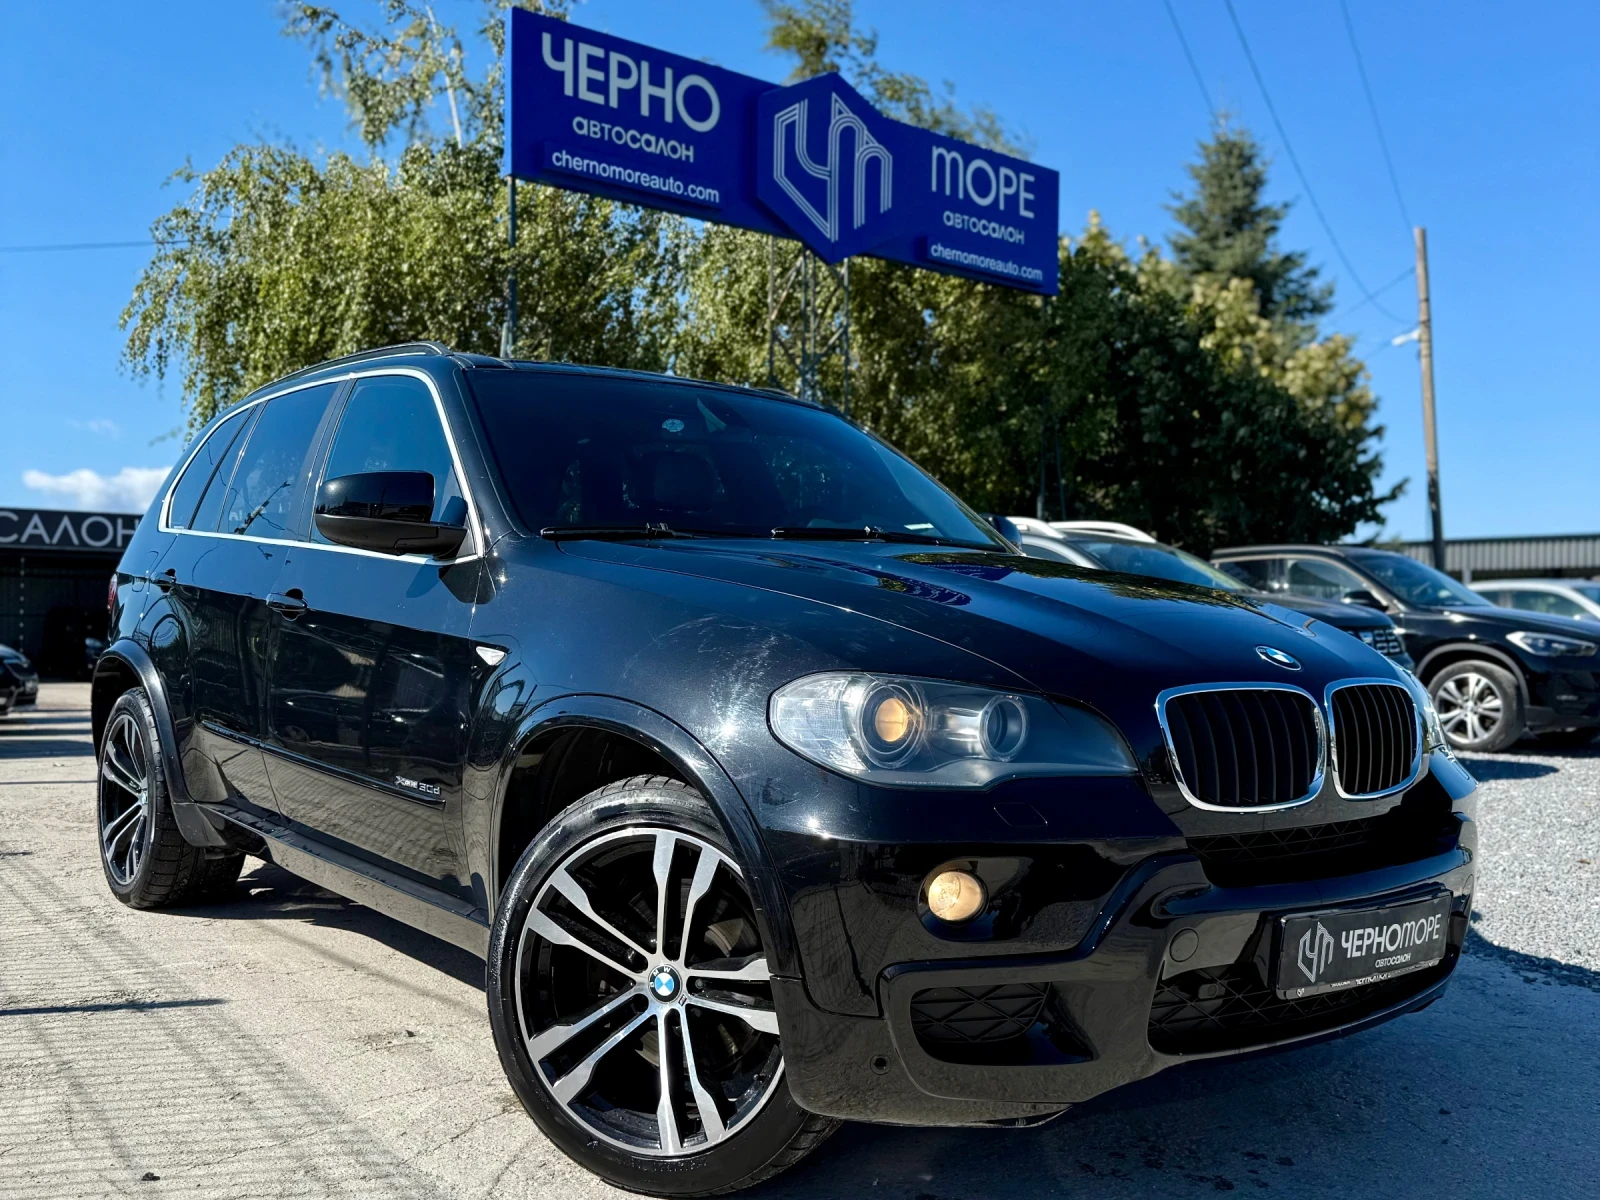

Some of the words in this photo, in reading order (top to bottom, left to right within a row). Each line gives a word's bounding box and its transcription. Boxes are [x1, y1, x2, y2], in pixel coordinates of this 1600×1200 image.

[541, 31, 721, 133] ЧЕРНО
[572, 116, 694, 163] автосалон
[552, 149, 720, 204] chernomoreauto.com
[943, 210, 1026, 245] автосалон
[930, 242, 1043, 281] chernomoreauto.com
